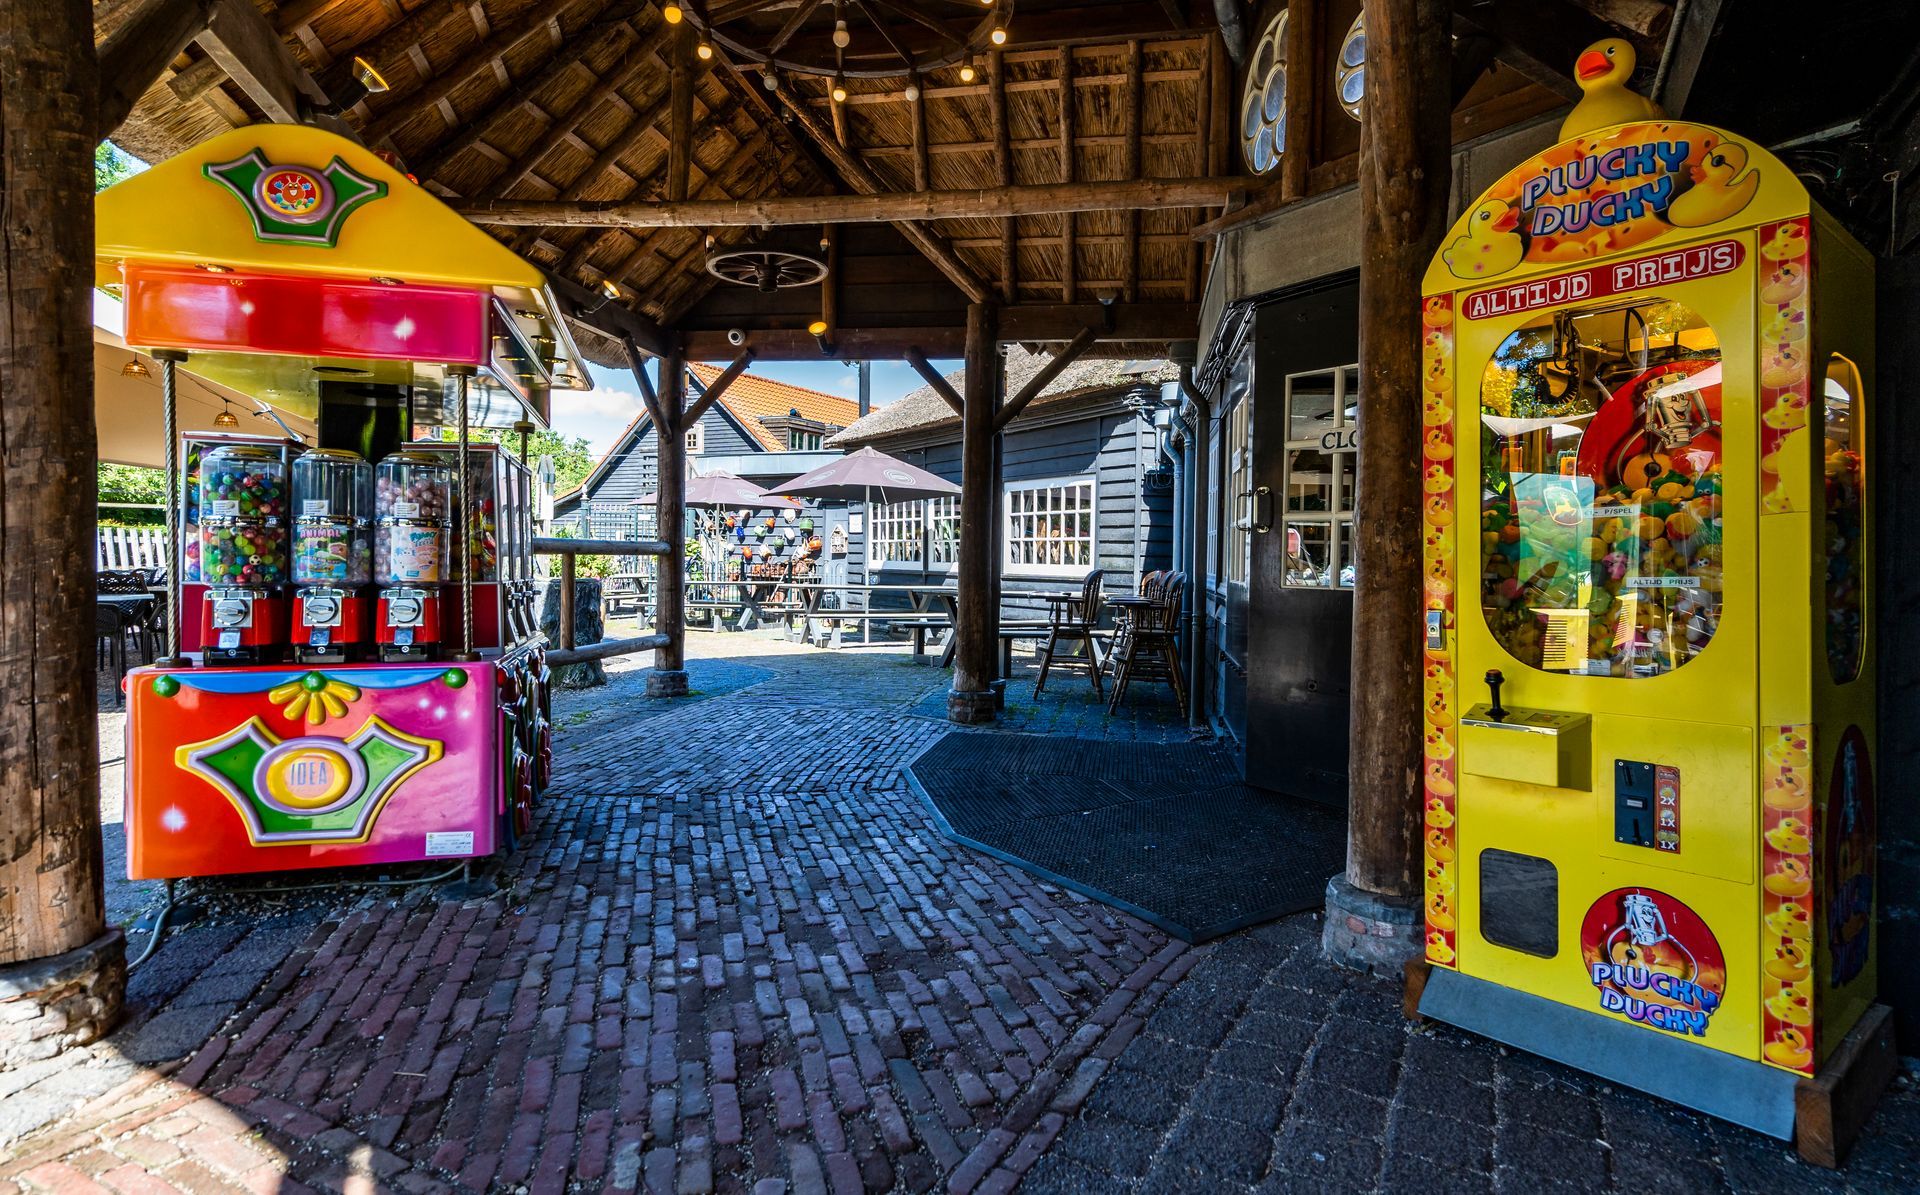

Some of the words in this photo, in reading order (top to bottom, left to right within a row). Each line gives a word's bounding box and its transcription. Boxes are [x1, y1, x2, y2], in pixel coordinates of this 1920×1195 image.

[1522, 141, 1690, 213] PLUCKY
[1531, 175, 1674, 237] DUCKY
[1471, 275, 1589, 318] ALTIJD
[1615, 246, 1733, 290] PRIJS
[300, 528, 341, 539] ANIMAL
[290, 761, 328, 786] IDEA
[1592, 962, 1718, 1014] PLUCKY
[1600, 986, 1707, 1037] DUCKY
